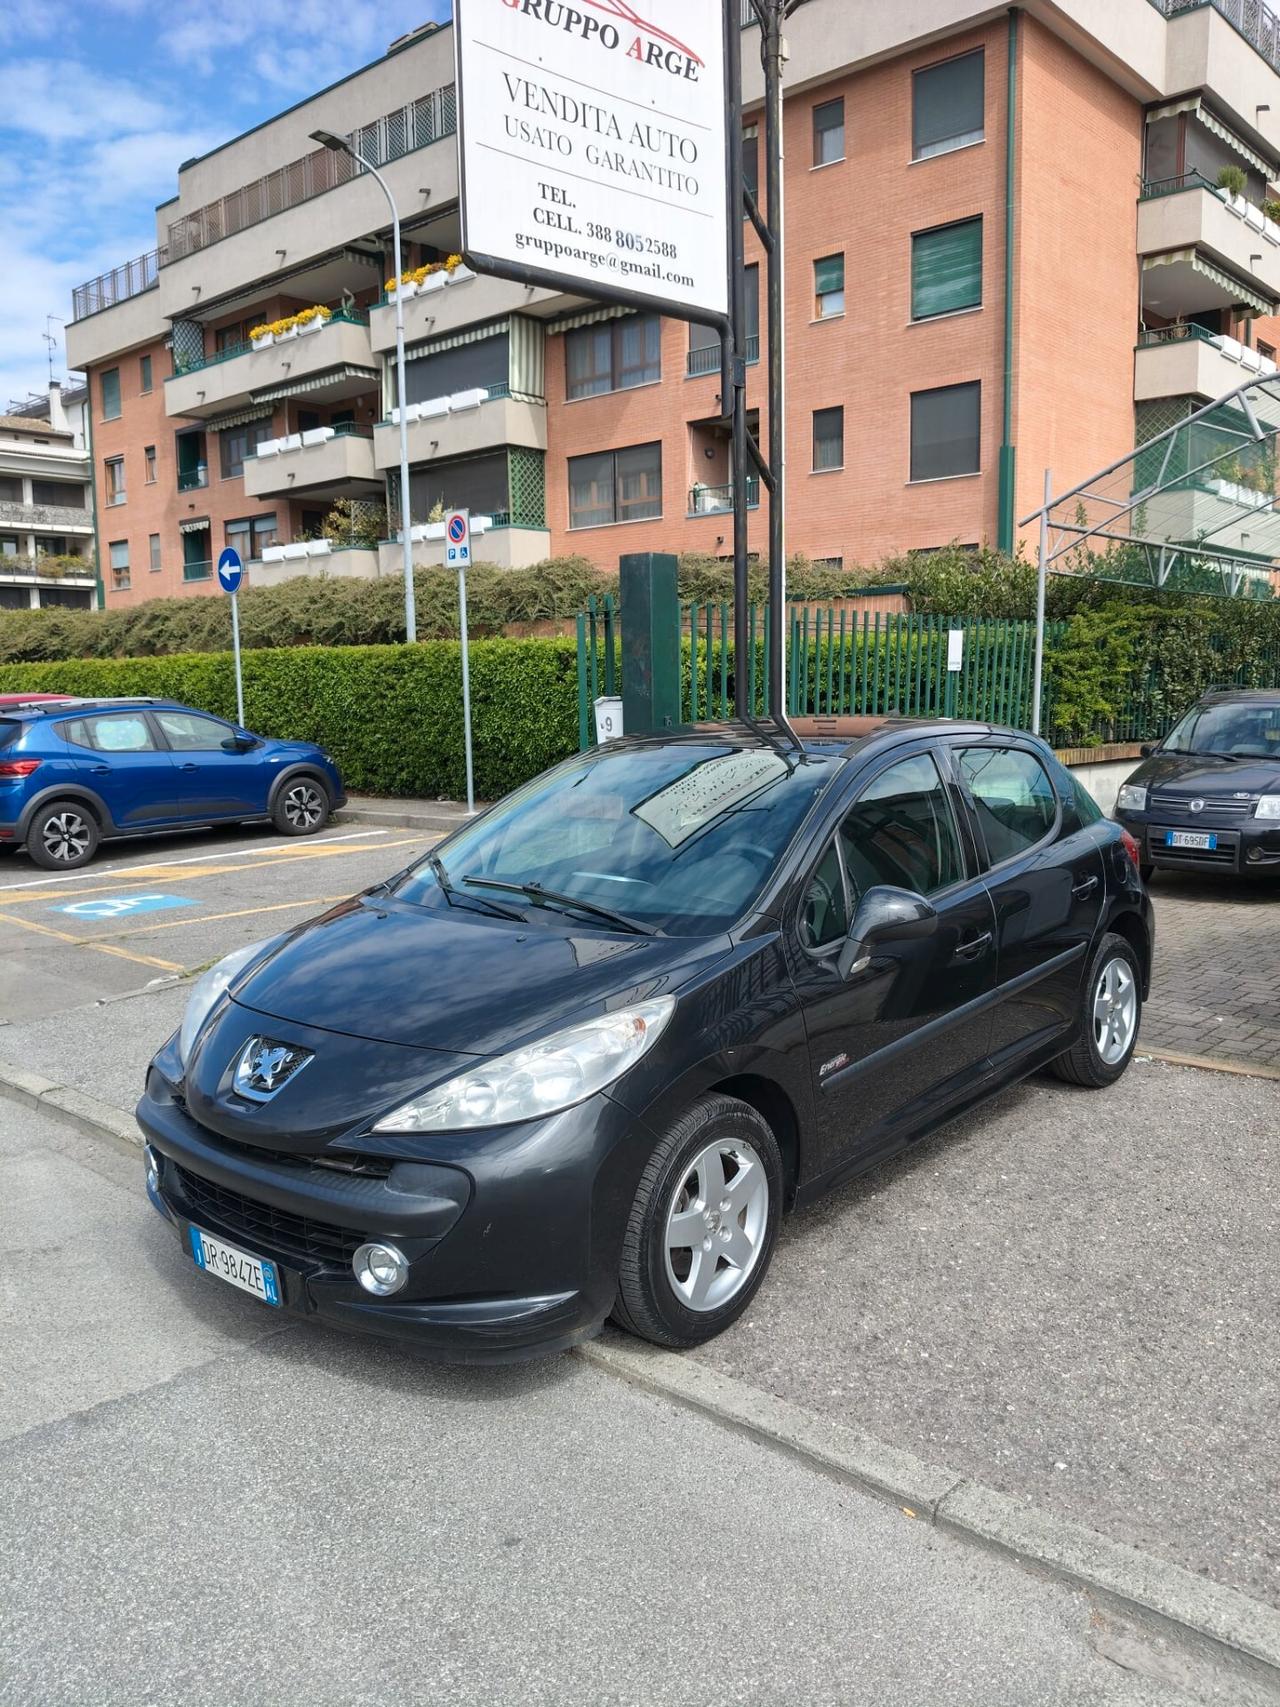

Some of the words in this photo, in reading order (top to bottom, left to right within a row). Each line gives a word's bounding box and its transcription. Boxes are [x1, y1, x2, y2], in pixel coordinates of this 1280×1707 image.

[625, 36, 700, 83] ARGE
[502, 71, 623, 141] VENDITA
[629, 121, 698, 164] AUTO
[504, 114, 572, 157] USATO
[585, 144, 699, 196] GARANTITO
[537, 182, 577, 209] TEL.
[533, 207, 582, 235] CELL.
[515, 231, 695, 288] gruppoarge@gmail.com
[605, 716, 613, 732] 9
